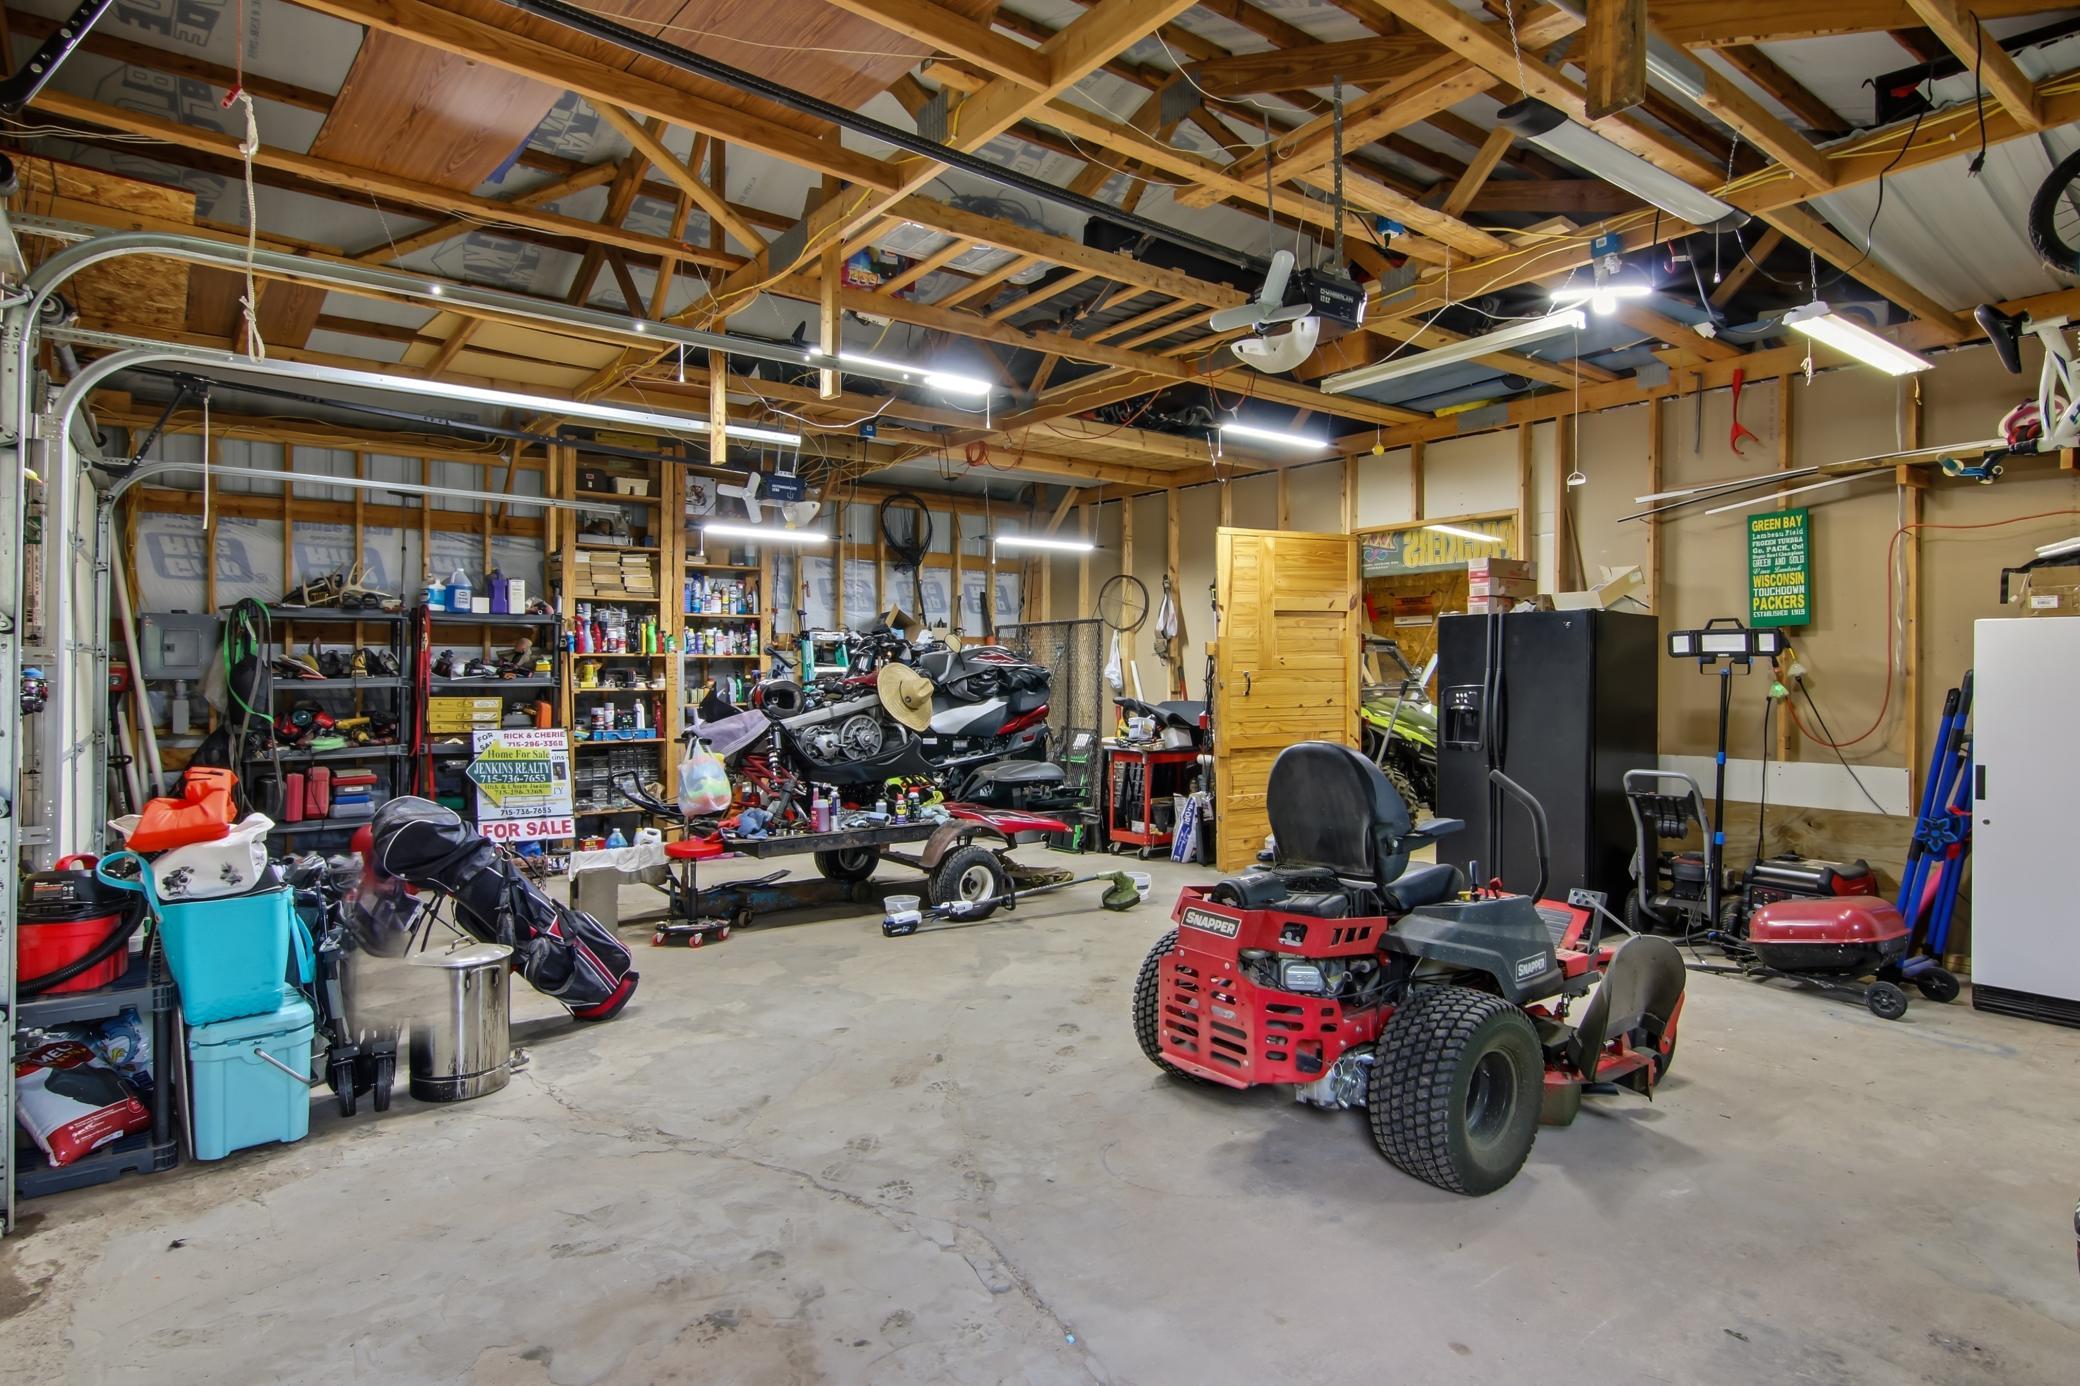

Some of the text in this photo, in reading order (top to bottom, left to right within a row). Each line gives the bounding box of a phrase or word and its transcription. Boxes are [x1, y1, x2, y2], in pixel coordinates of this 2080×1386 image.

[1752, 515, 1803, 532] GREEN BAY
[1753, 571, 1805, 588] WISCONSIN
[1753, 585, 1805, 597] TOUCHDOWN
[1753, 594, 1805, 611] PACKERS
[477, 732, 494, 742] FOR
[534, 731, 565, 739] CHERIE
[487, 749, 514, 759] Home
[516, 748, 531, 759] For
[532, 748, 550, 759] Sale
[474, 761, 551, 775] JENKINS REALTY
[481, 774, 546, 783] 715-736-7653
[483, 820, 573, 839] FOR SALE
[1186, 912, 1236, 934] SNAPPER
